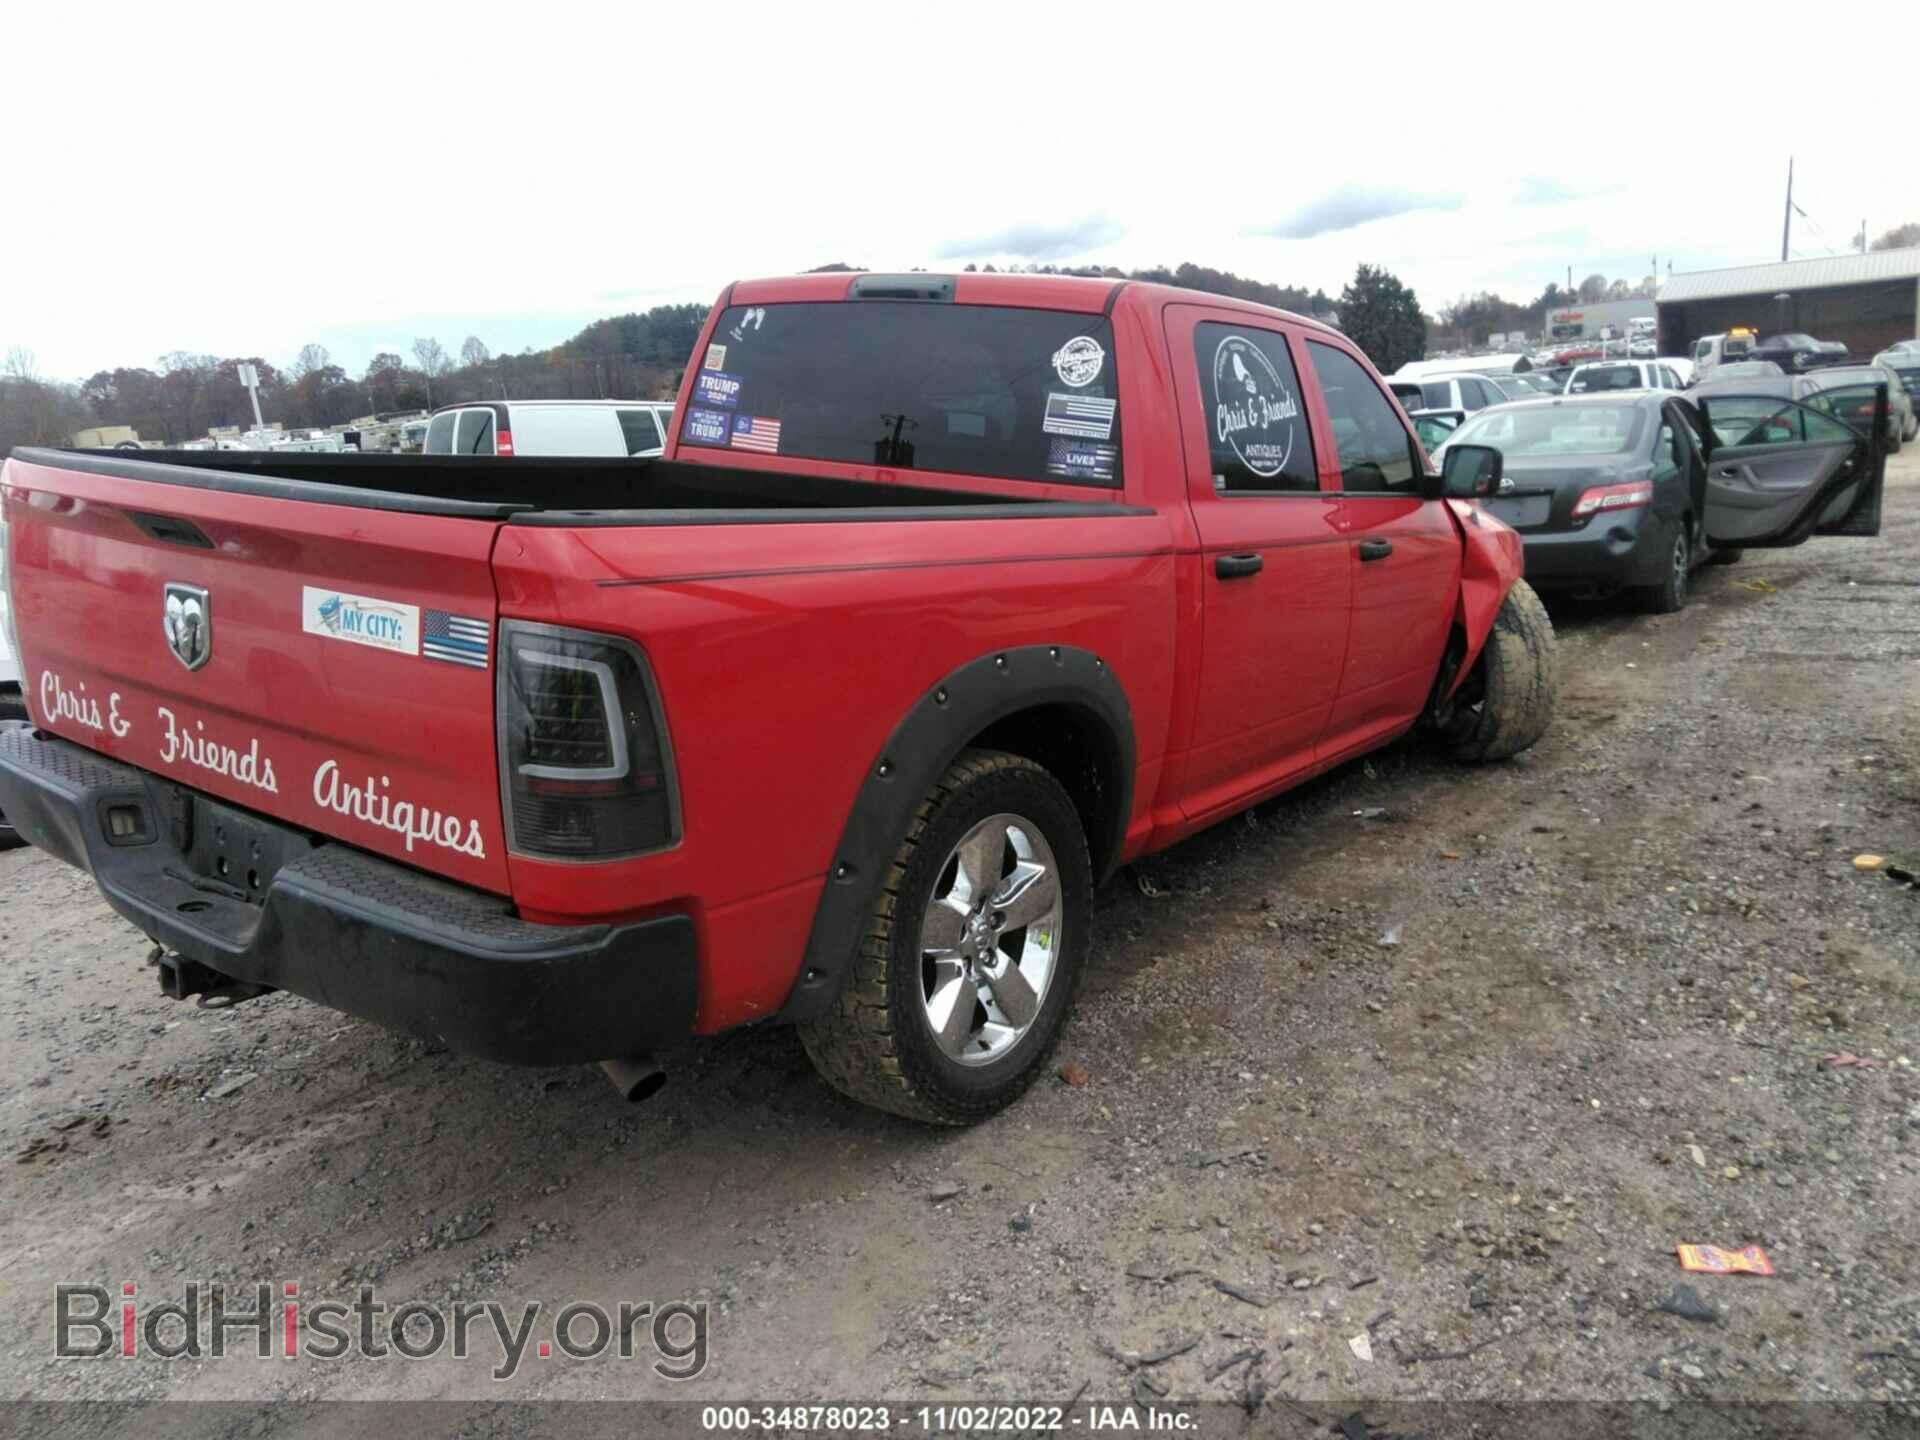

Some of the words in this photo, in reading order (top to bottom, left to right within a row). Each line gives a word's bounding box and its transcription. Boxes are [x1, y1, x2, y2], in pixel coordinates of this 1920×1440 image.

[701, 376, 740, 394] TRUMP
[691, 422, 724, 439] TRUMP
[1217, 401, 1248, 442] Chris
[1248, 398, 1258, 426] &
[1259, 391, 1297, 429] Friends
[1066, 453, 1096, 466] LIVES
[1246, 444, 1282, 458] ANTIQUES
[343, 608, 363, 632] MY
[366, 614, 402, 641] CITY:
[40, 670, 103, 730] Chris
[109, 692, 131, 737] &
[157, 707, 279, 793] Friends
[313, 759, 486, 859] Antiques
